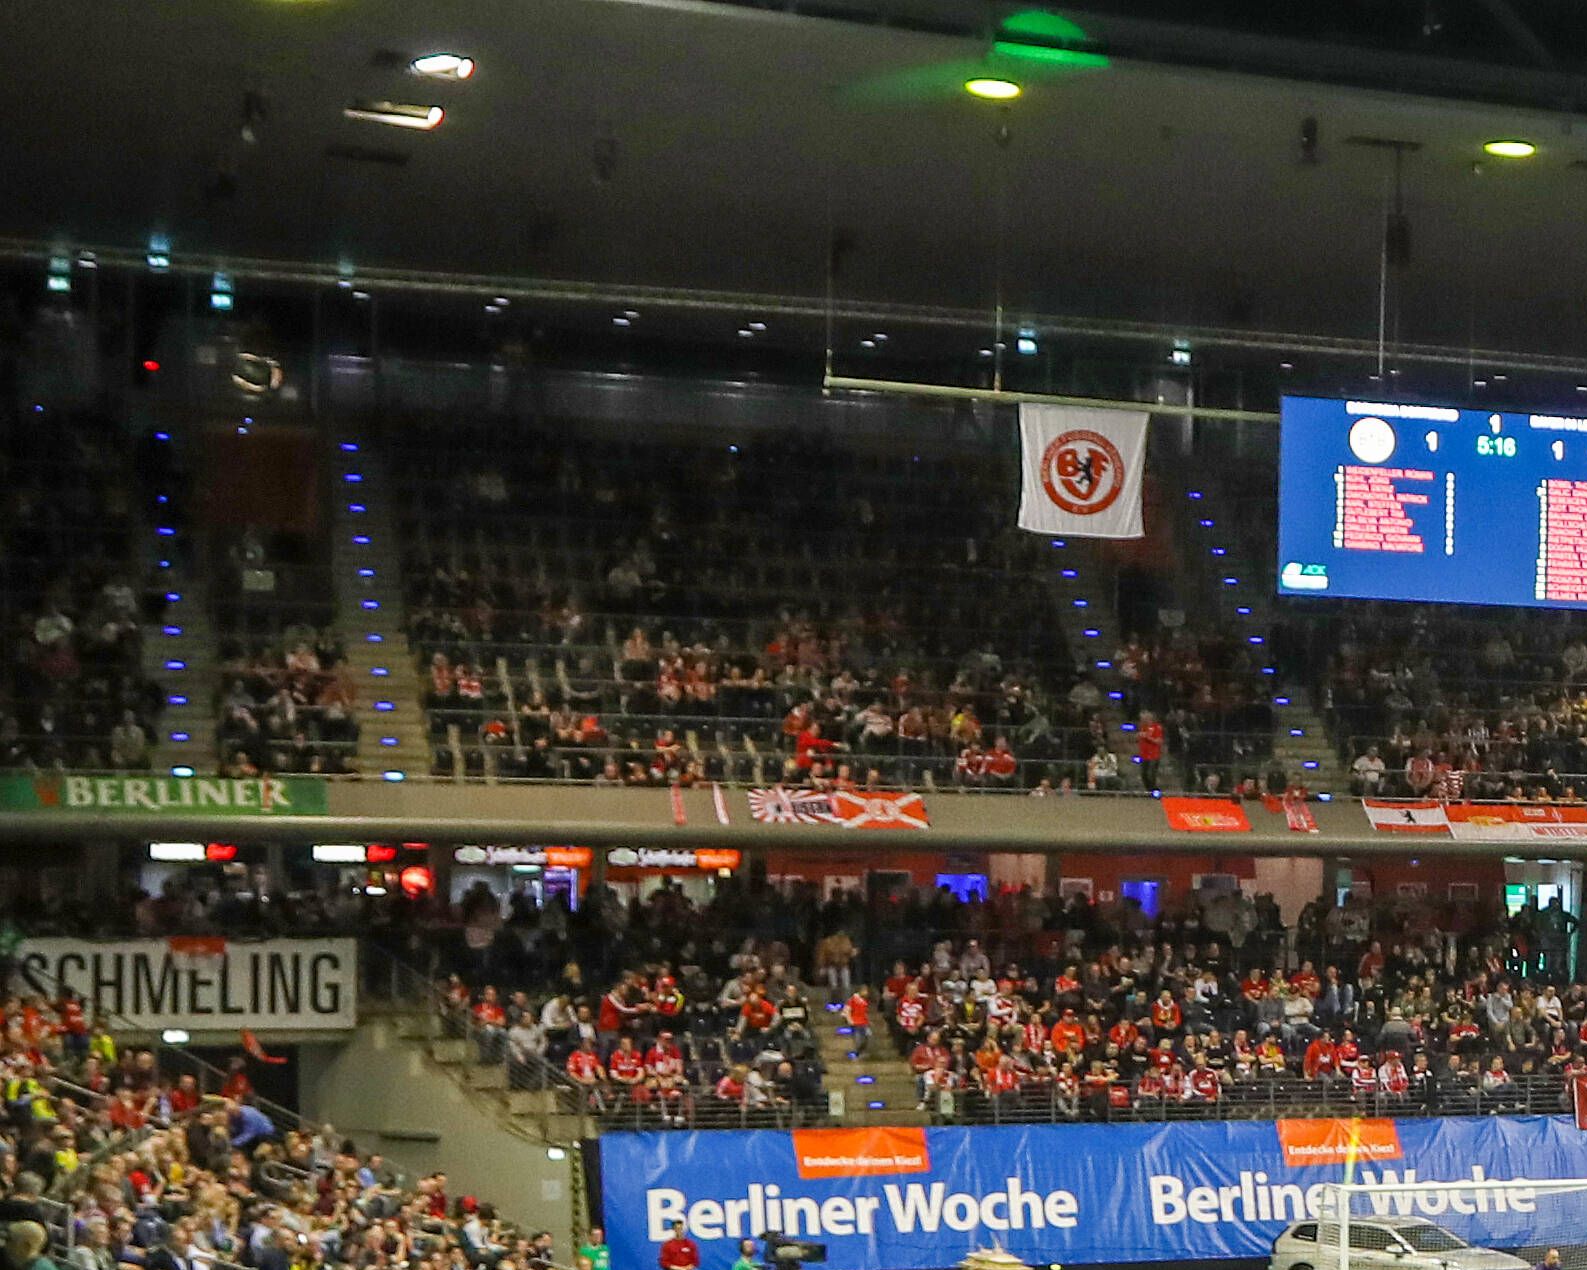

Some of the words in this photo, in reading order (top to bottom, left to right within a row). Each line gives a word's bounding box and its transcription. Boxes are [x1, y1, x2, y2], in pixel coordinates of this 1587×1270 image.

[1477, 435, 1516, 458] 5:16
[64, 776, 293, 809] BERLINER
[22, 951, 342, 1014] SCHMELING
[646, 1183, 880, 1242] Berliner
[884, 1177, 1078, 1233] Woche
[1361, 1165, 1537, 1216] Woche
